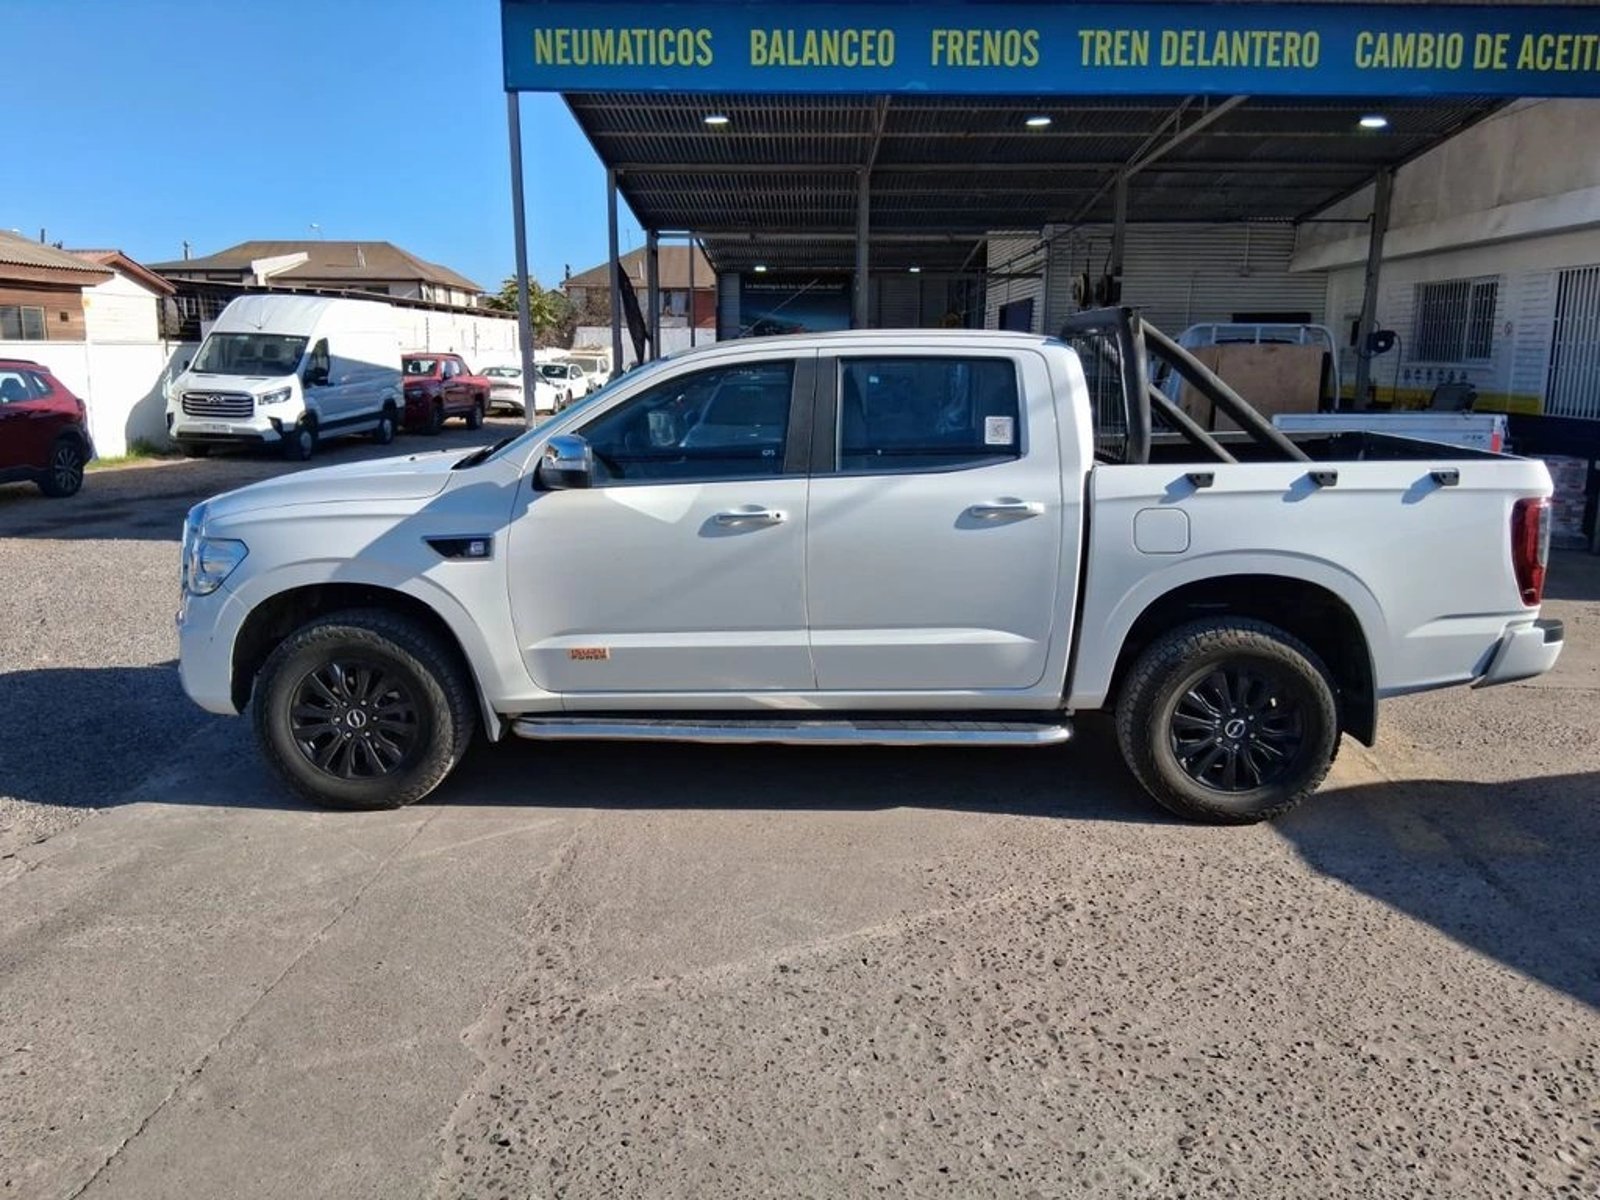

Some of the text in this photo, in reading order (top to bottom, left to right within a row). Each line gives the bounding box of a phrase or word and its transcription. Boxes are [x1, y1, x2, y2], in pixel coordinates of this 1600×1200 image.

[533, 27, 714, 67] NEUMATICOS
[749, 28, 896, 68] BALANCEO
[931, 28, 1040, 68] FRENOS
[1078, 29, 1320, 69] TREN DELANTERO
[1354, 31, 1464, 70] CAMBIO
[1473, 33, 1511, 70] DE
